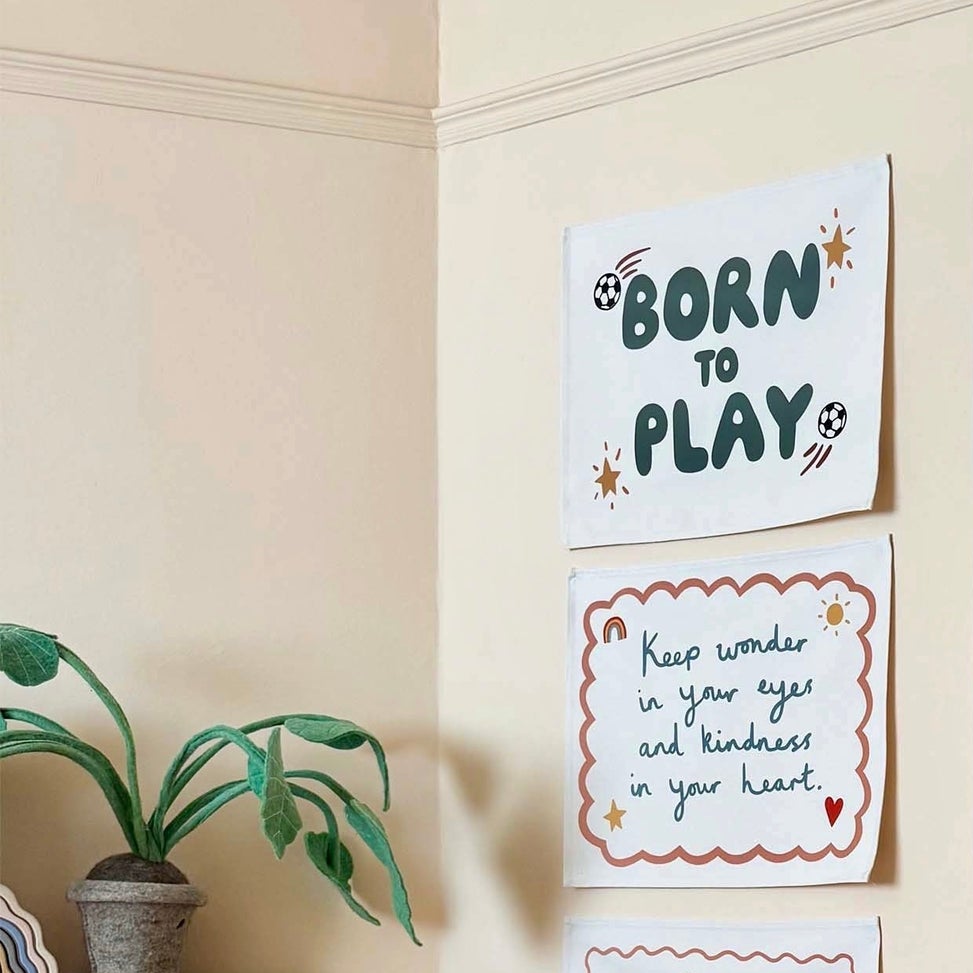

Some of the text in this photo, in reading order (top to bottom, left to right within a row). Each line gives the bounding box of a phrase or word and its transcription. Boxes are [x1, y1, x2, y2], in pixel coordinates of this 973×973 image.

[622, 242, 820, 350] BORN
[694, 346, 739, 387] TO
[634, 382, 814, 477] PLAY
[640, 623, 808, 677] Keep wonder
[637, 678, 813, 727] in your eyes
[639, 721, 812, 758] and kindness
[630, 762, 823, 822] in your heart.
